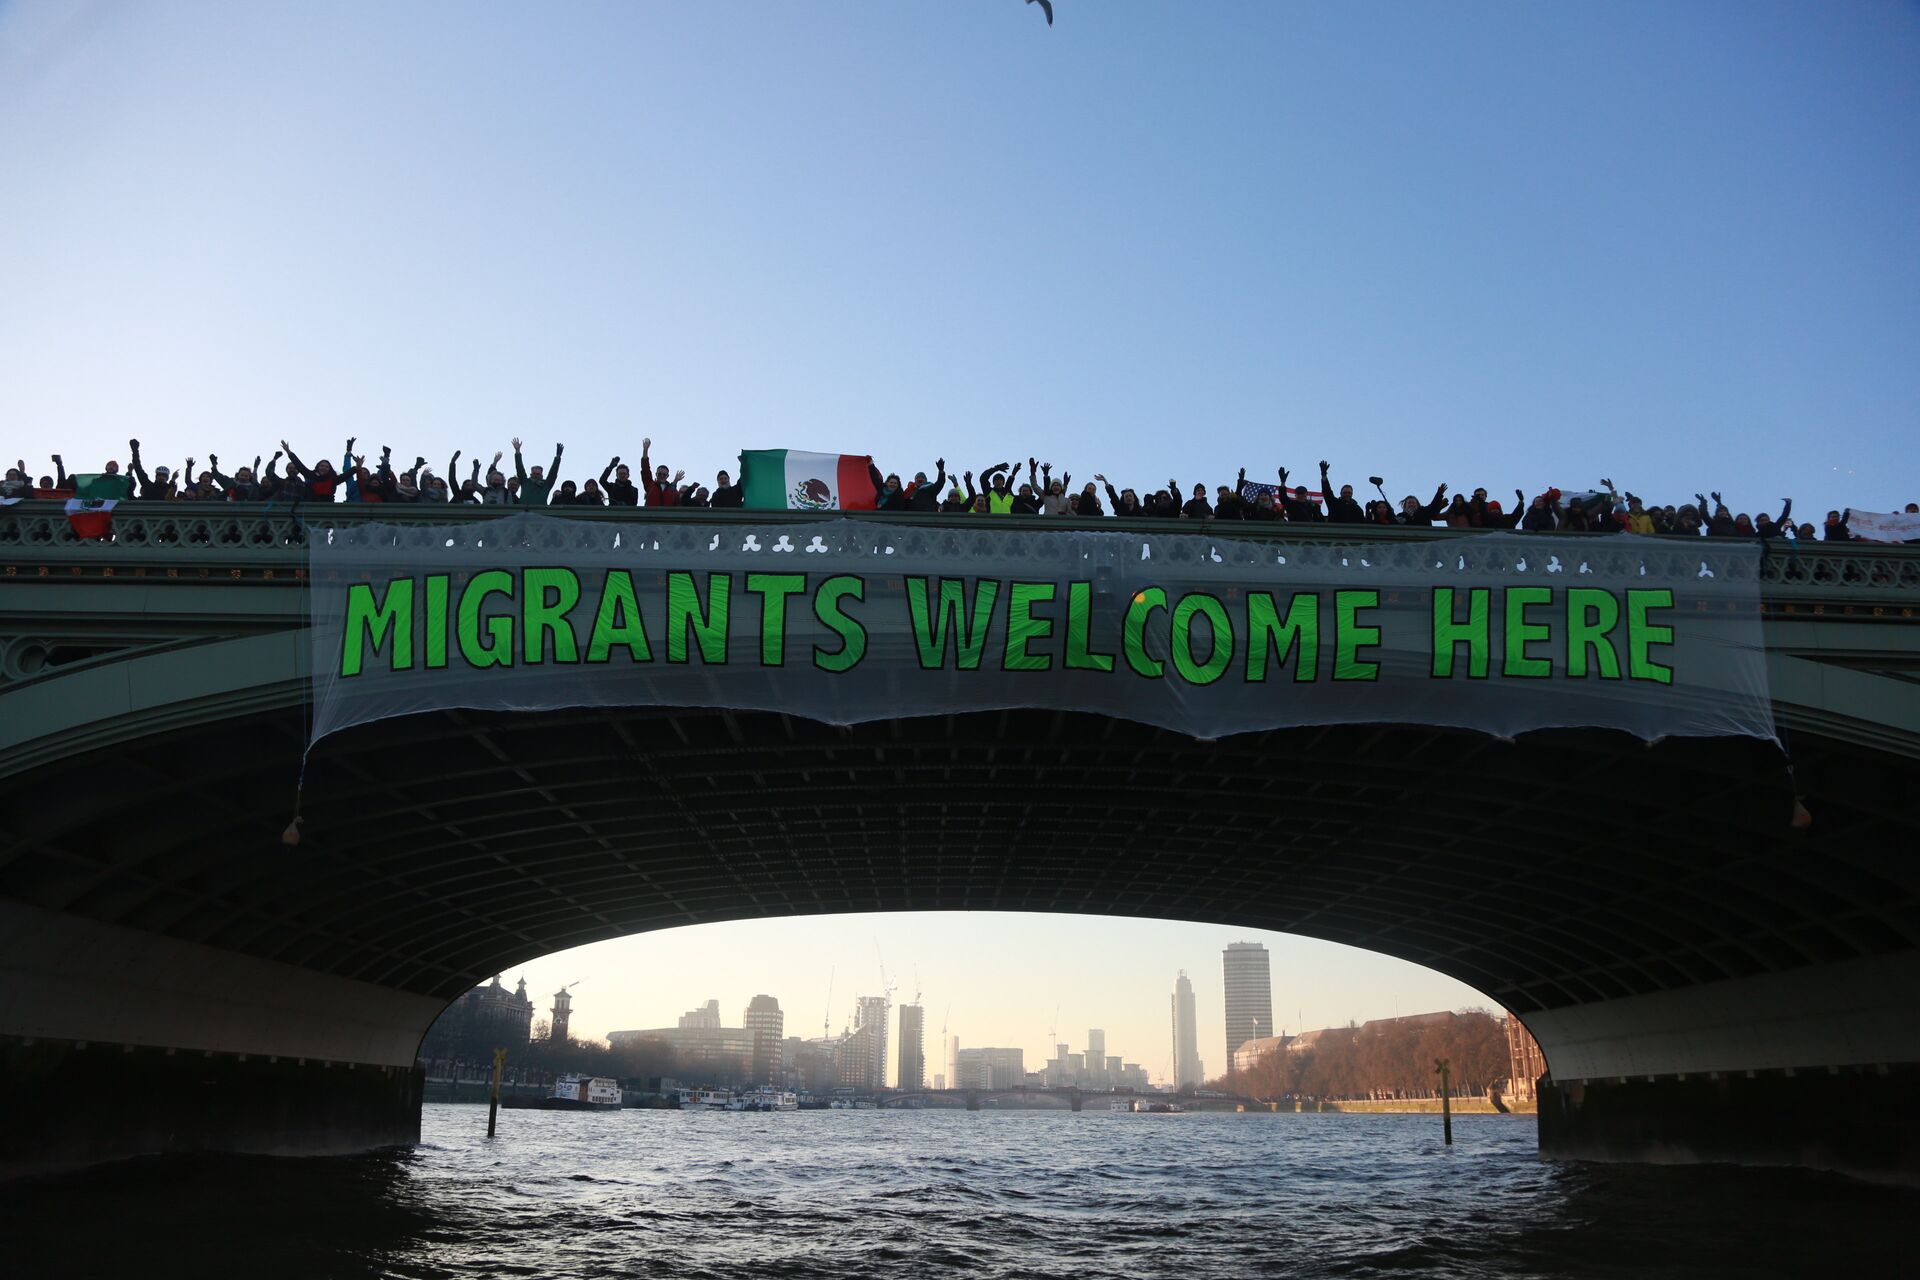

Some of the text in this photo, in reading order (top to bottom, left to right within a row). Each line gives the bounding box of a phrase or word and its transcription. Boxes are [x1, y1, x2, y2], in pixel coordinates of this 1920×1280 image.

[340, 567, 1675, 685] MIGRANTS WELCOME HERE
